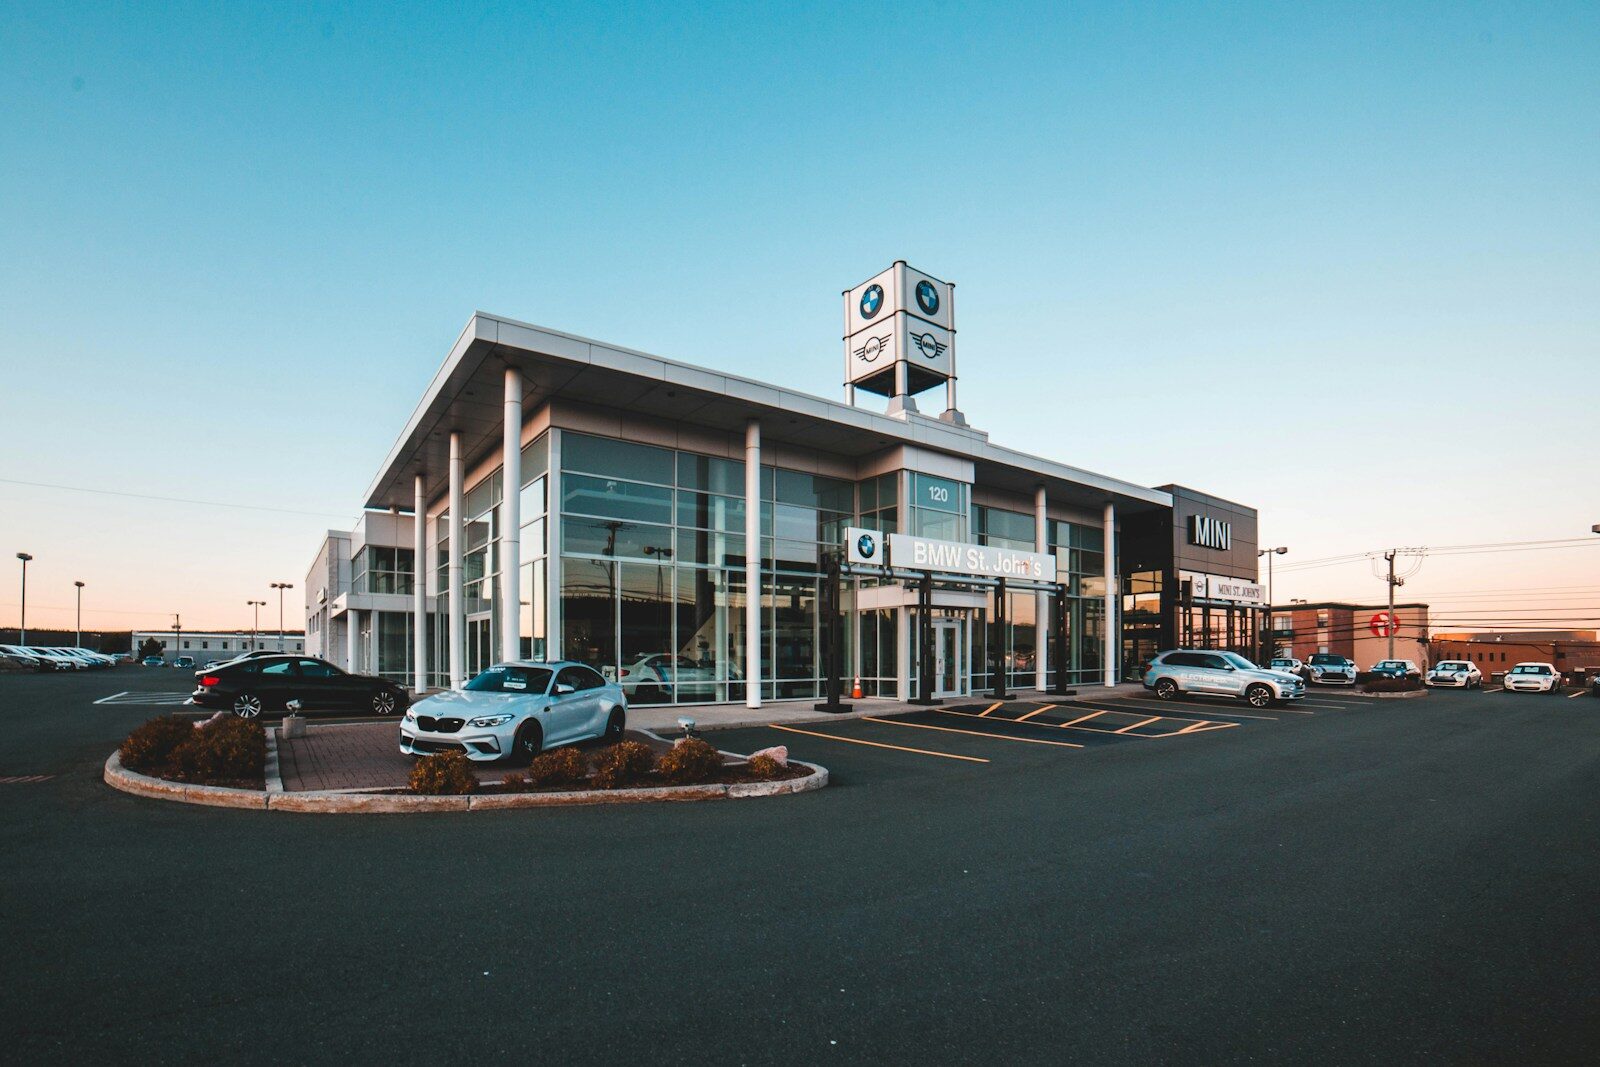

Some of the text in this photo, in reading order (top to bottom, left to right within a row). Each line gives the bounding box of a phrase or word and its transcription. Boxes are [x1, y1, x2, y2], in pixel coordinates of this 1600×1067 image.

[928, 485, 948, 503] 120
[1195, 515, 1231, 551] MINI
[914, 541, 1041, 577] BMW St. John's
[1218, 583, 1232, 596] MINI
[1233, 585, 1241, 597] ST.
[1242, 586, 1260, 599] JOHN'S
